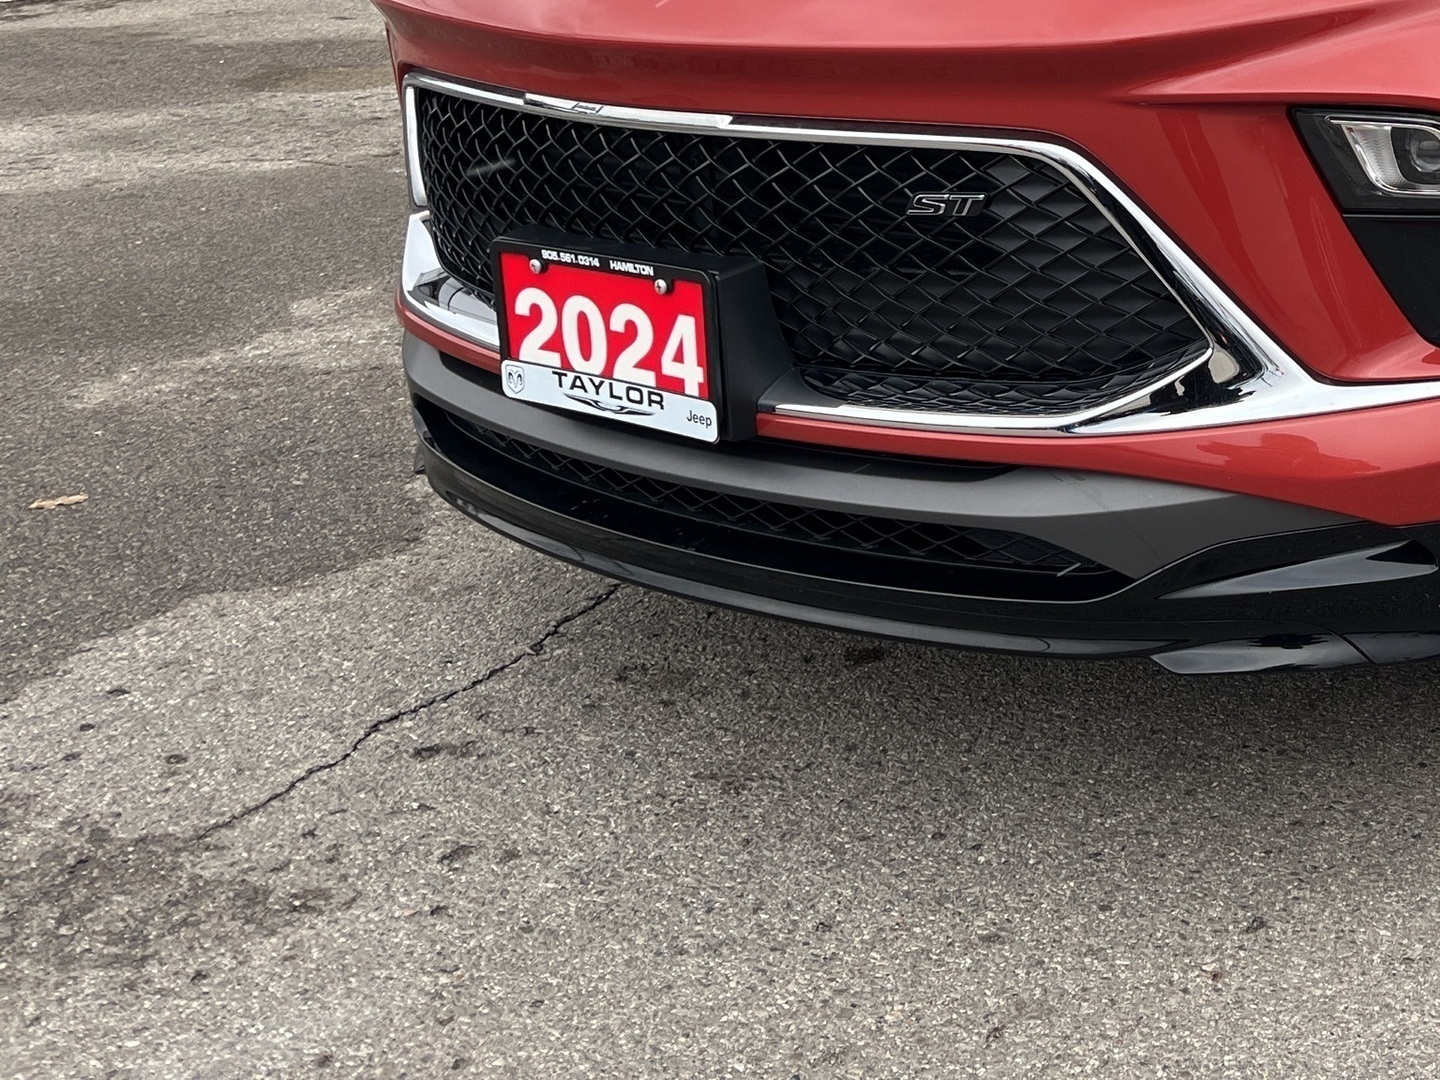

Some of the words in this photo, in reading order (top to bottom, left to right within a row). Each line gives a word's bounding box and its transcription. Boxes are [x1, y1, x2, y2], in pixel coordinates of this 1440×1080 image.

[907, 193, 985, 217] ST
[609, 260, 654, 276] HAMILTON
[514, 287, 704, 397] 2024
[551, 370, 665, 410] TAYLOR
[687, 410, 713, 429] Jeep
